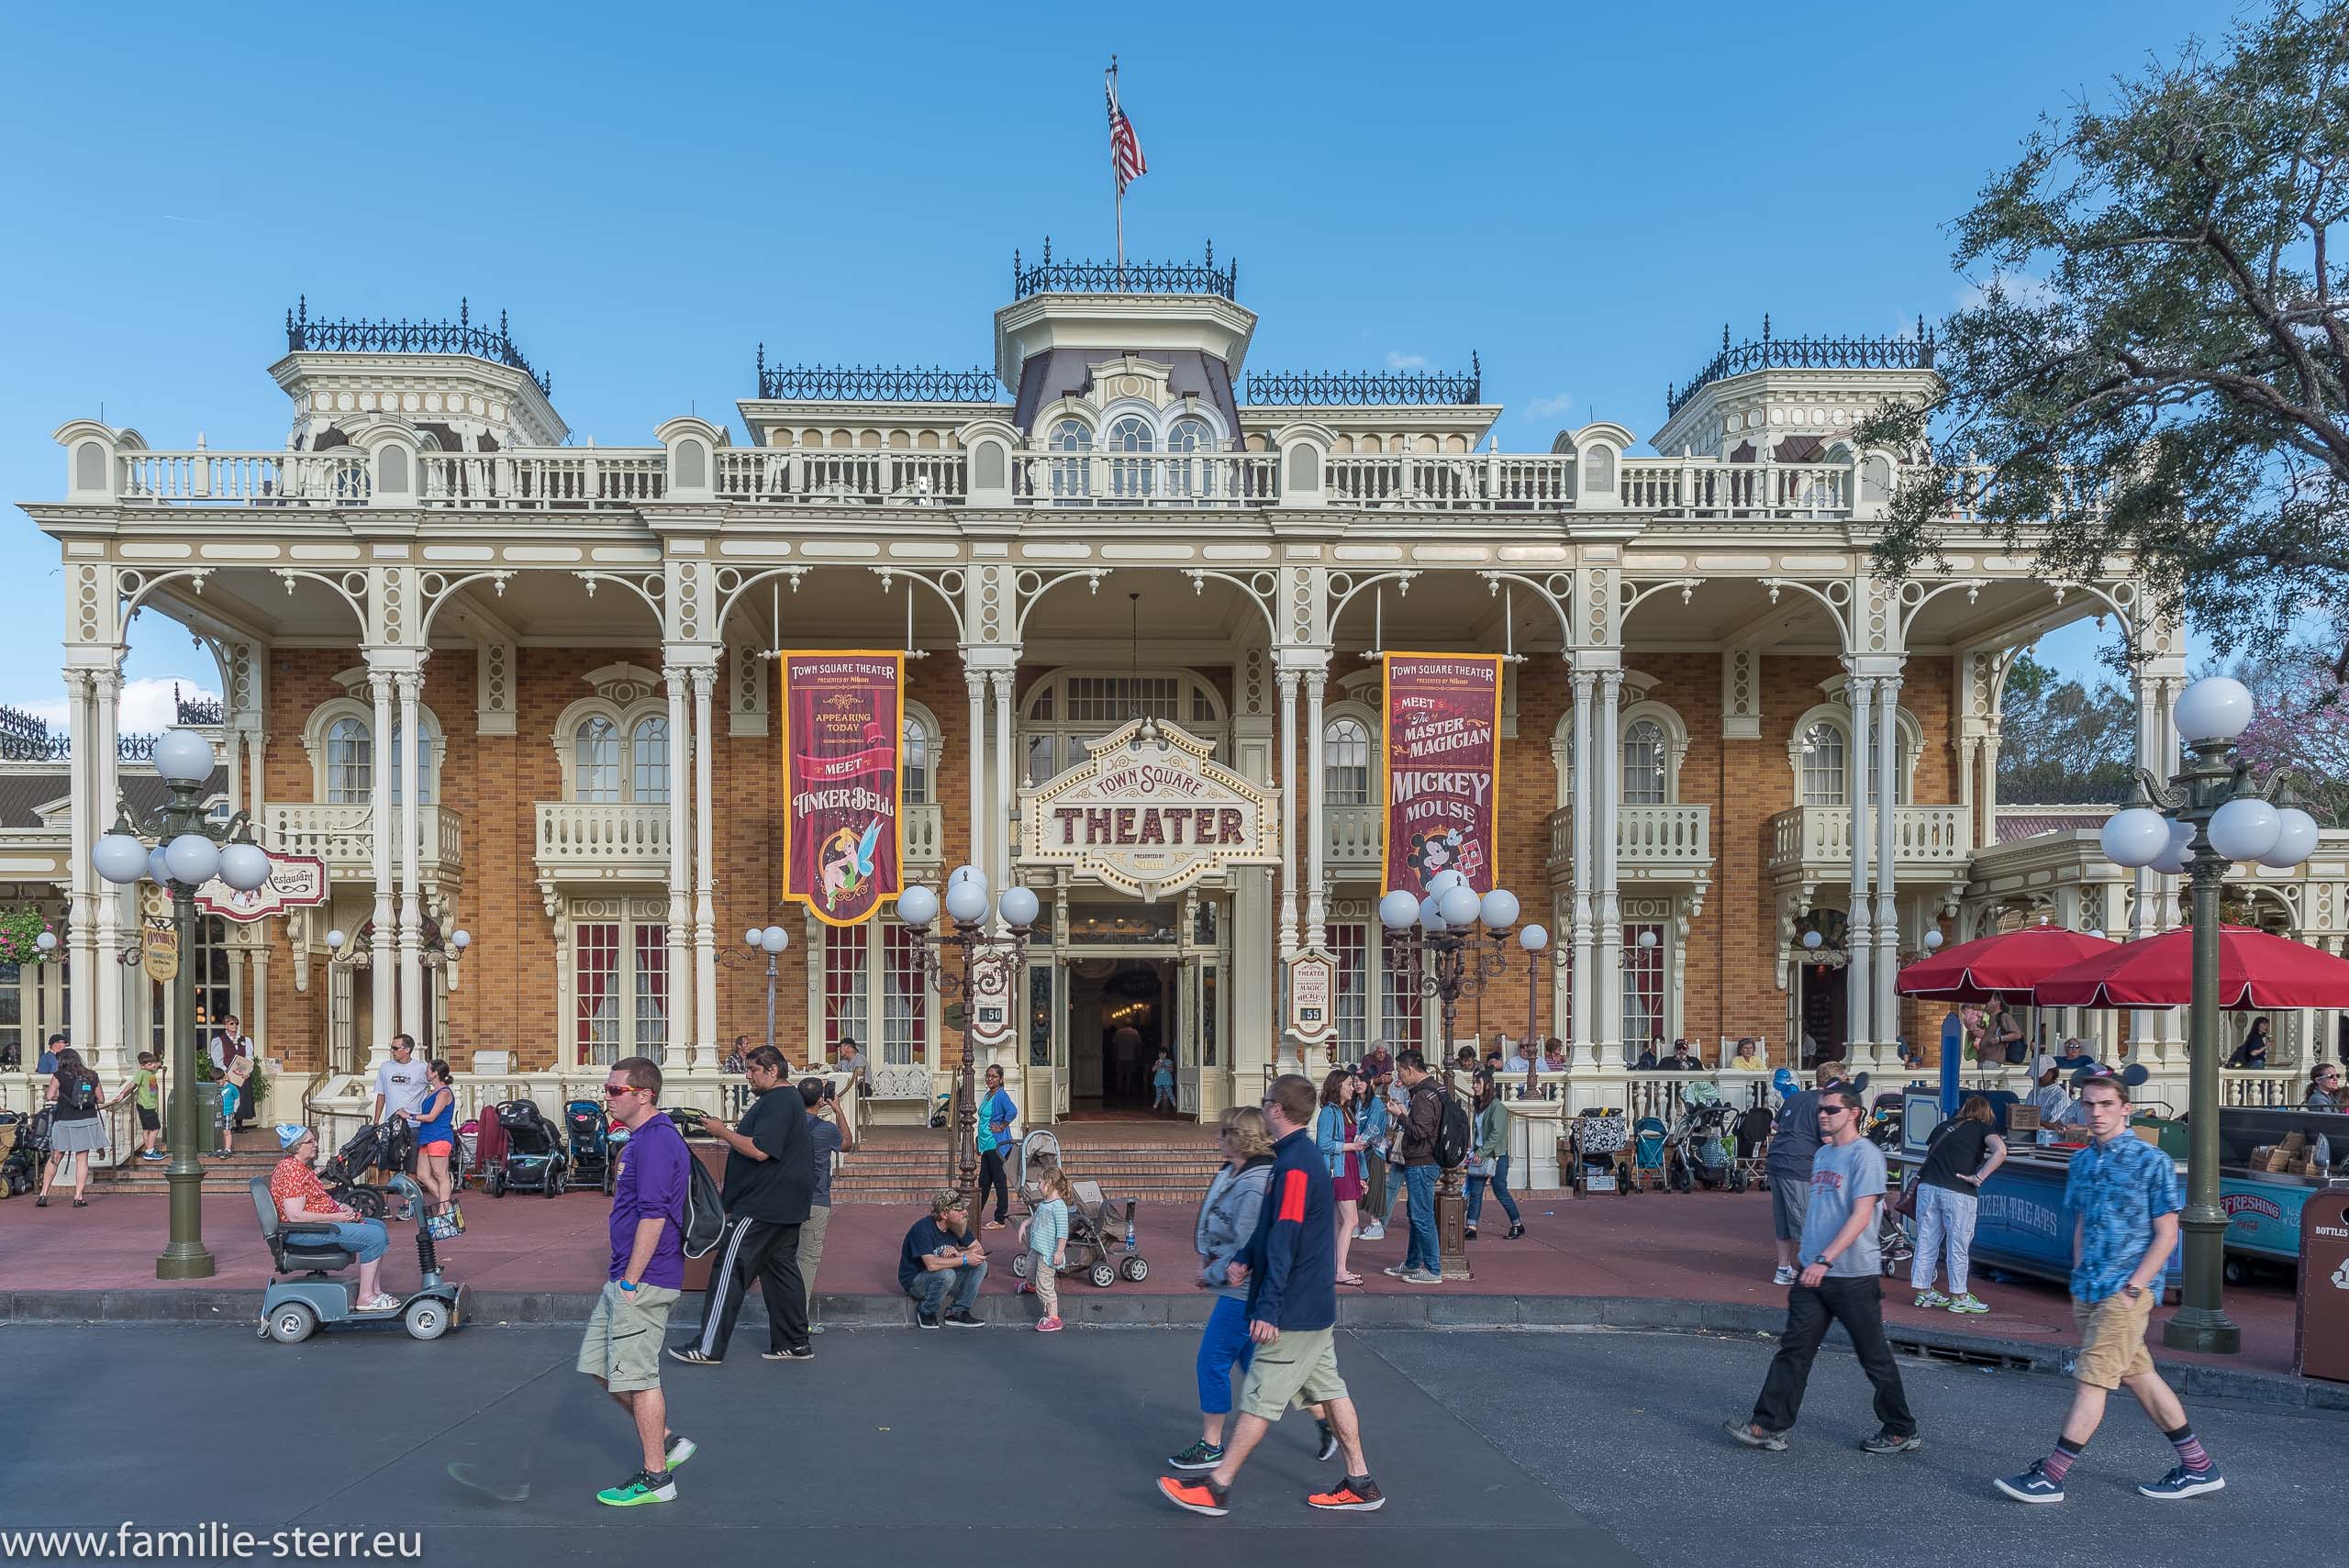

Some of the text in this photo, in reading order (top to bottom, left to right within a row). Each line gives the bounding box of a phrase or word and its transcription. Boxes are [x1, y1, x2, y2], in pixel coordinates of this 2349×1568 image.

[792, 663, 895, 680] TOWN SQUARE THEATER
[1391, 664, 1494, 683] TOWN SQUARE THEATER
[1449, 677, 1468, 685] Nikon
[1401, 697, 1435, 709] MEET
[816, 713, 872, 722] APPEARING
[1411, 711, 1431, 726] The
[827, 724, 860, 732] TODAY
[1404, 717, 1465, 742] MASTER
[1409, 728, 1492, 759] MAGICIAN
[825, 758, 863, 775] MEET
[1097, 764, 1204, 796] TOWN SQUARE
[1391, 772, 1491, 808] MICKEY
[792, 786, 895, 819] TINKER BELL
[1405, 800, 1476, 825] MOUSE
[1053, 807, 1245, 844] THEATER
[147, 931, 176, 951] OMNIBUS
[1297, 993, 1326, 1003] MICKEY
[988, 1009, 1001, 1020] 50
[1307, 1009, 1319, 1020] 55
[2220, 1195, 2280, 1218] FRESHING
[1977, 1195, 2057, 1238] OZEN TREATS
[2315, 1226, 2349, 1238] BOTTLES
